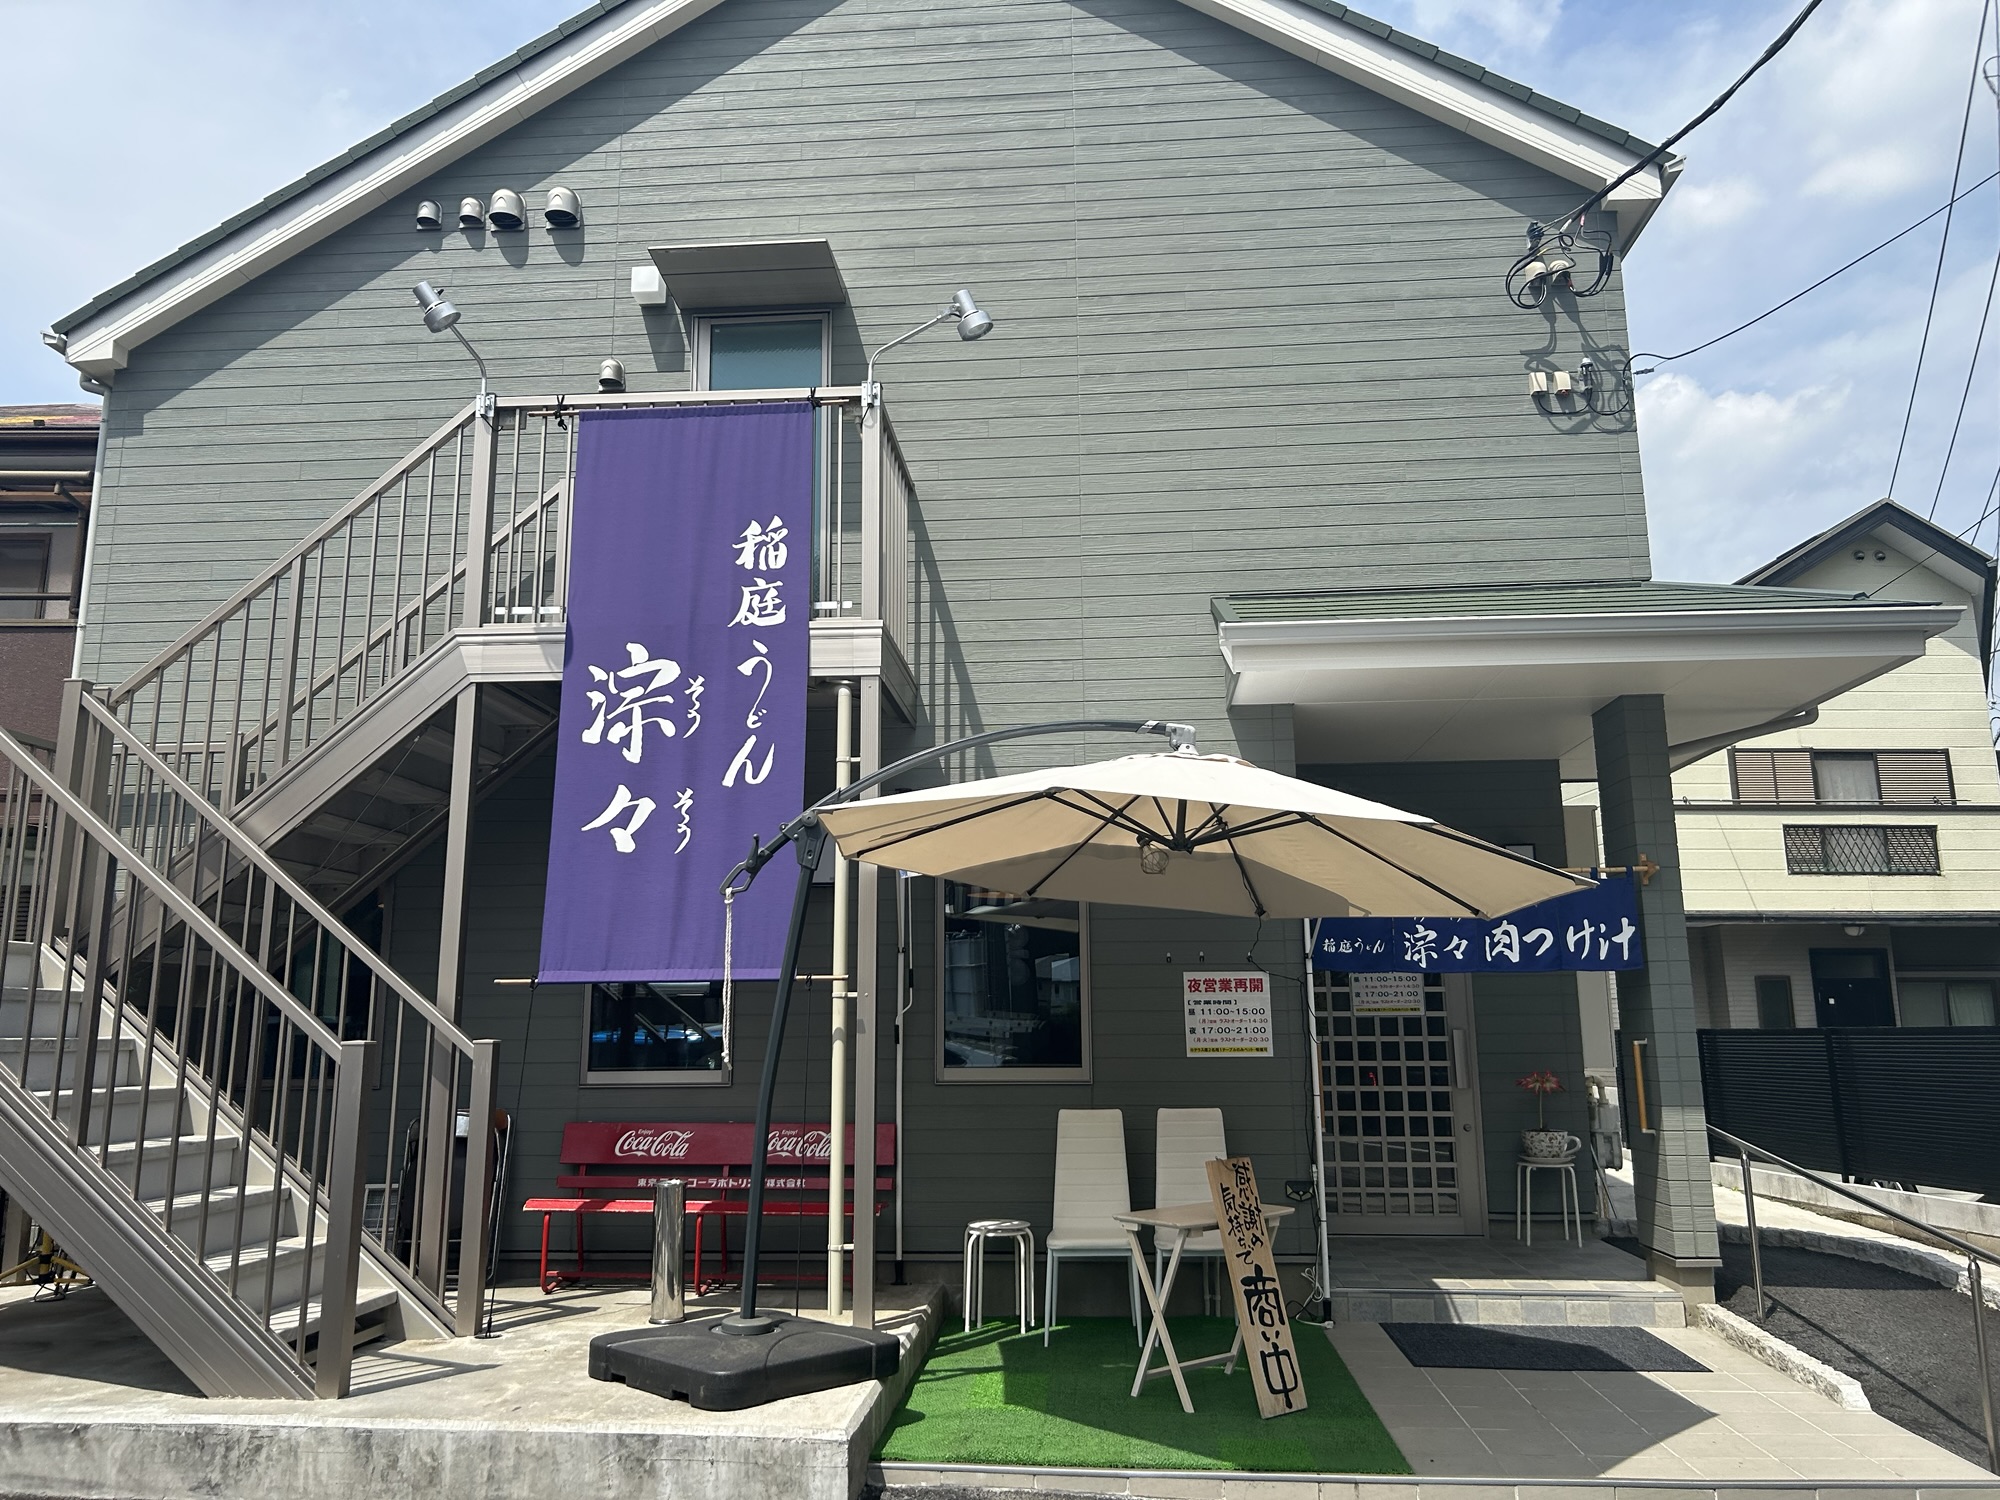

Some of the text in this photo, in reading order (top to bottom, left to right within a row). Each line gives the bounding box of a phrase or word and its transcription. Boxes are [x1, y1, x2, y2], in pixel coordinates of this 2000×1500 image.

[721, 514, 790, 788] 稲庭うどん
[672, 674, 706, 854] そう そう
[1322, 937, 1386, 955] 稲庭うどん
[1485, 917, 1636, 963] 肉つけ汁
[1187, 977, 1264, 993] 夜営業再開
[1189, 1027, 1197, 1035] 夜
[1232, 1160, 1264, 1248] 感謝の
[1240, 1264, 1298, 1410] 商い中
